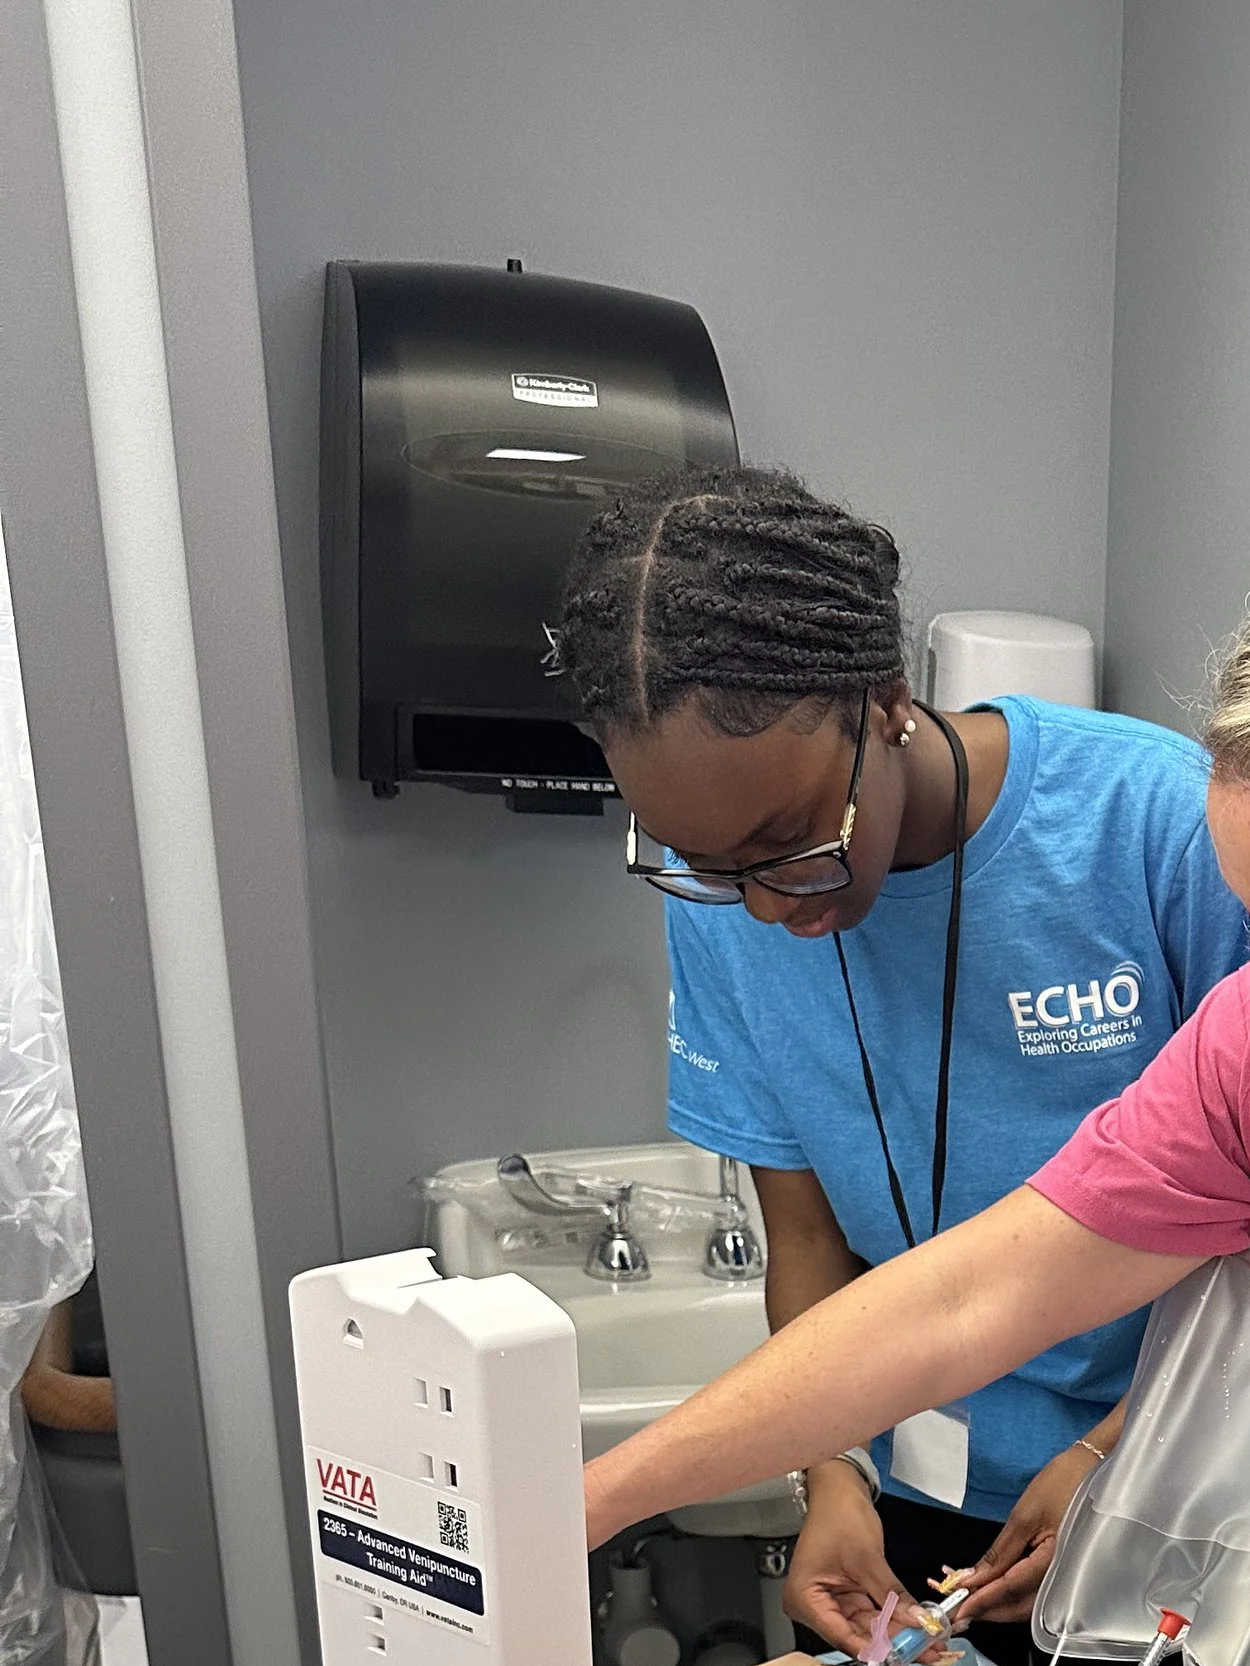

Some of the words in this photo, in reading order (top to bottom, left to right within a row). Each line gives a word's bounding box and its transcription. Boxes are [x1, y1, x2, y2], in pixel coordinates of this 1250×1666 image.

[1008, 974, 1140, 1031] ECHO
[1018, 1028, 1079, 1045] Exploring
[1080, 1018, 1130, 1038] Careers
[1131, 1014, 1143, 1027] in
[1020, 1042, 1060, 1057] Health
[1061, 1031, 1137, 1054] Occupations
[316, 1458, 377, 1507] VATA
[323, 1517, 348, 1537] 2365
[357, 1529, 407, 1560] Advanced
[408, 1549, 477, 1586] Venipuncture
[366, 1551, 408, 1582] Training
